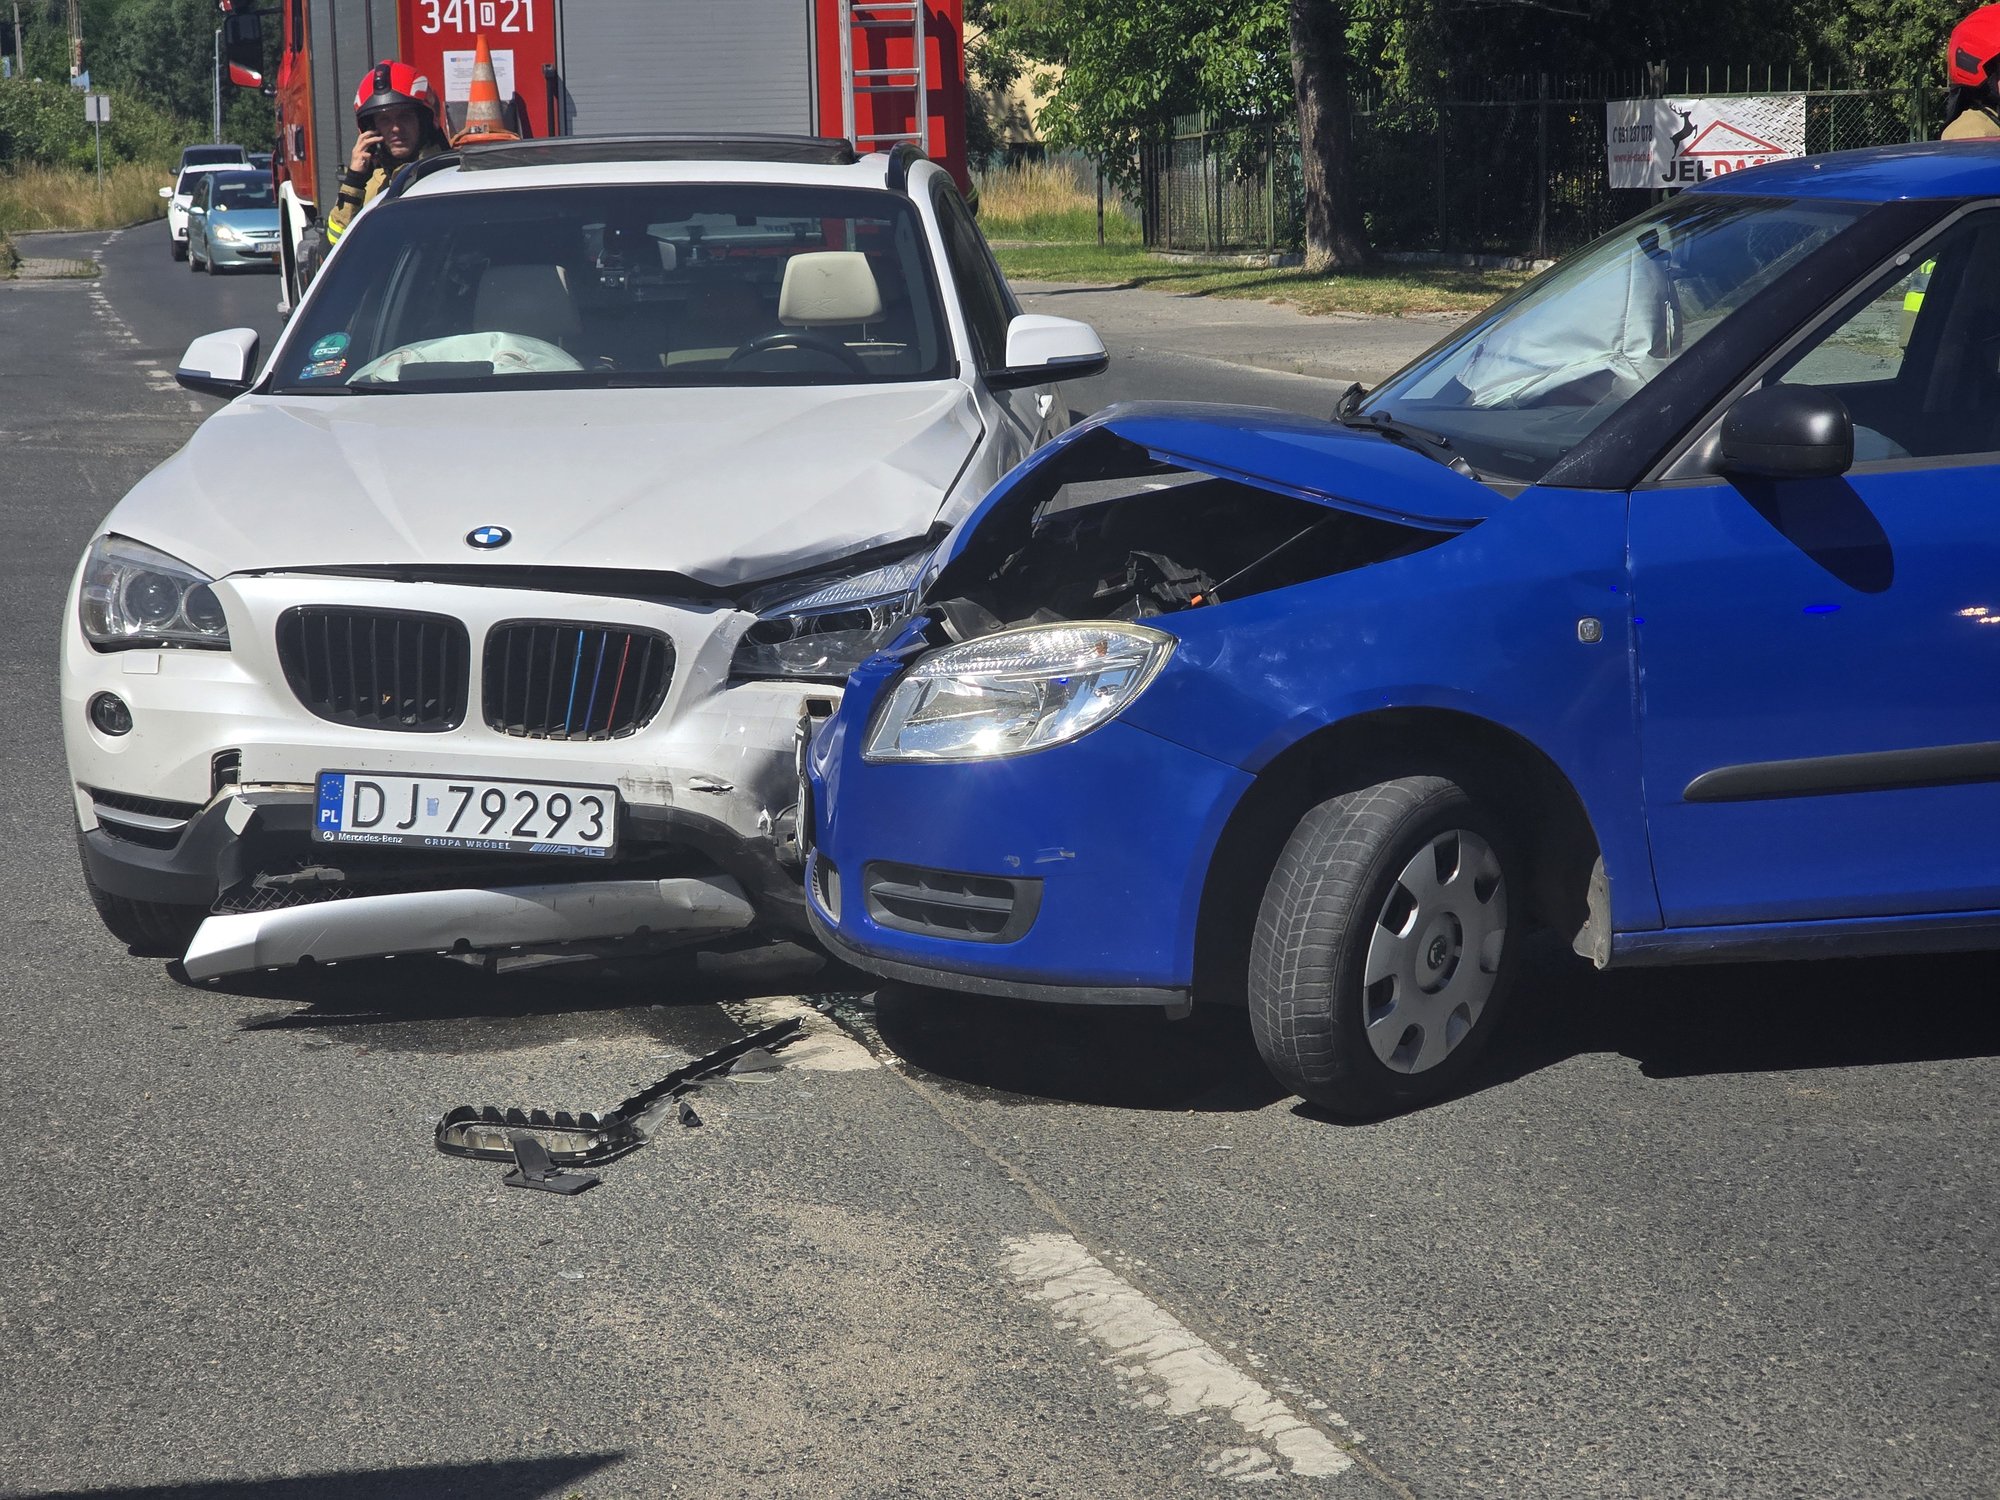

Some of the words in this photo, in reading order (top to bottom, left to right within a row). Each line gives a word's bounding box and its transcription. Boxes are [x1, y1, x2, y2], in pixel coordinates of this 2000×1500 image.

[421, 0, 476, 33] 341
[501, 0, 534, 32] 21
[321, 809, 339, 823] PL
[351, 781, 419, 829] DJ
[446, 785, 604, 842] 79293
[338, 833, 403, 844] Mercedes-Benz
[424, 838, 462, 849] GRUPA
[466, 839, 511, 850] WRÓBEL
[555, 845, 606, 857] AMG
